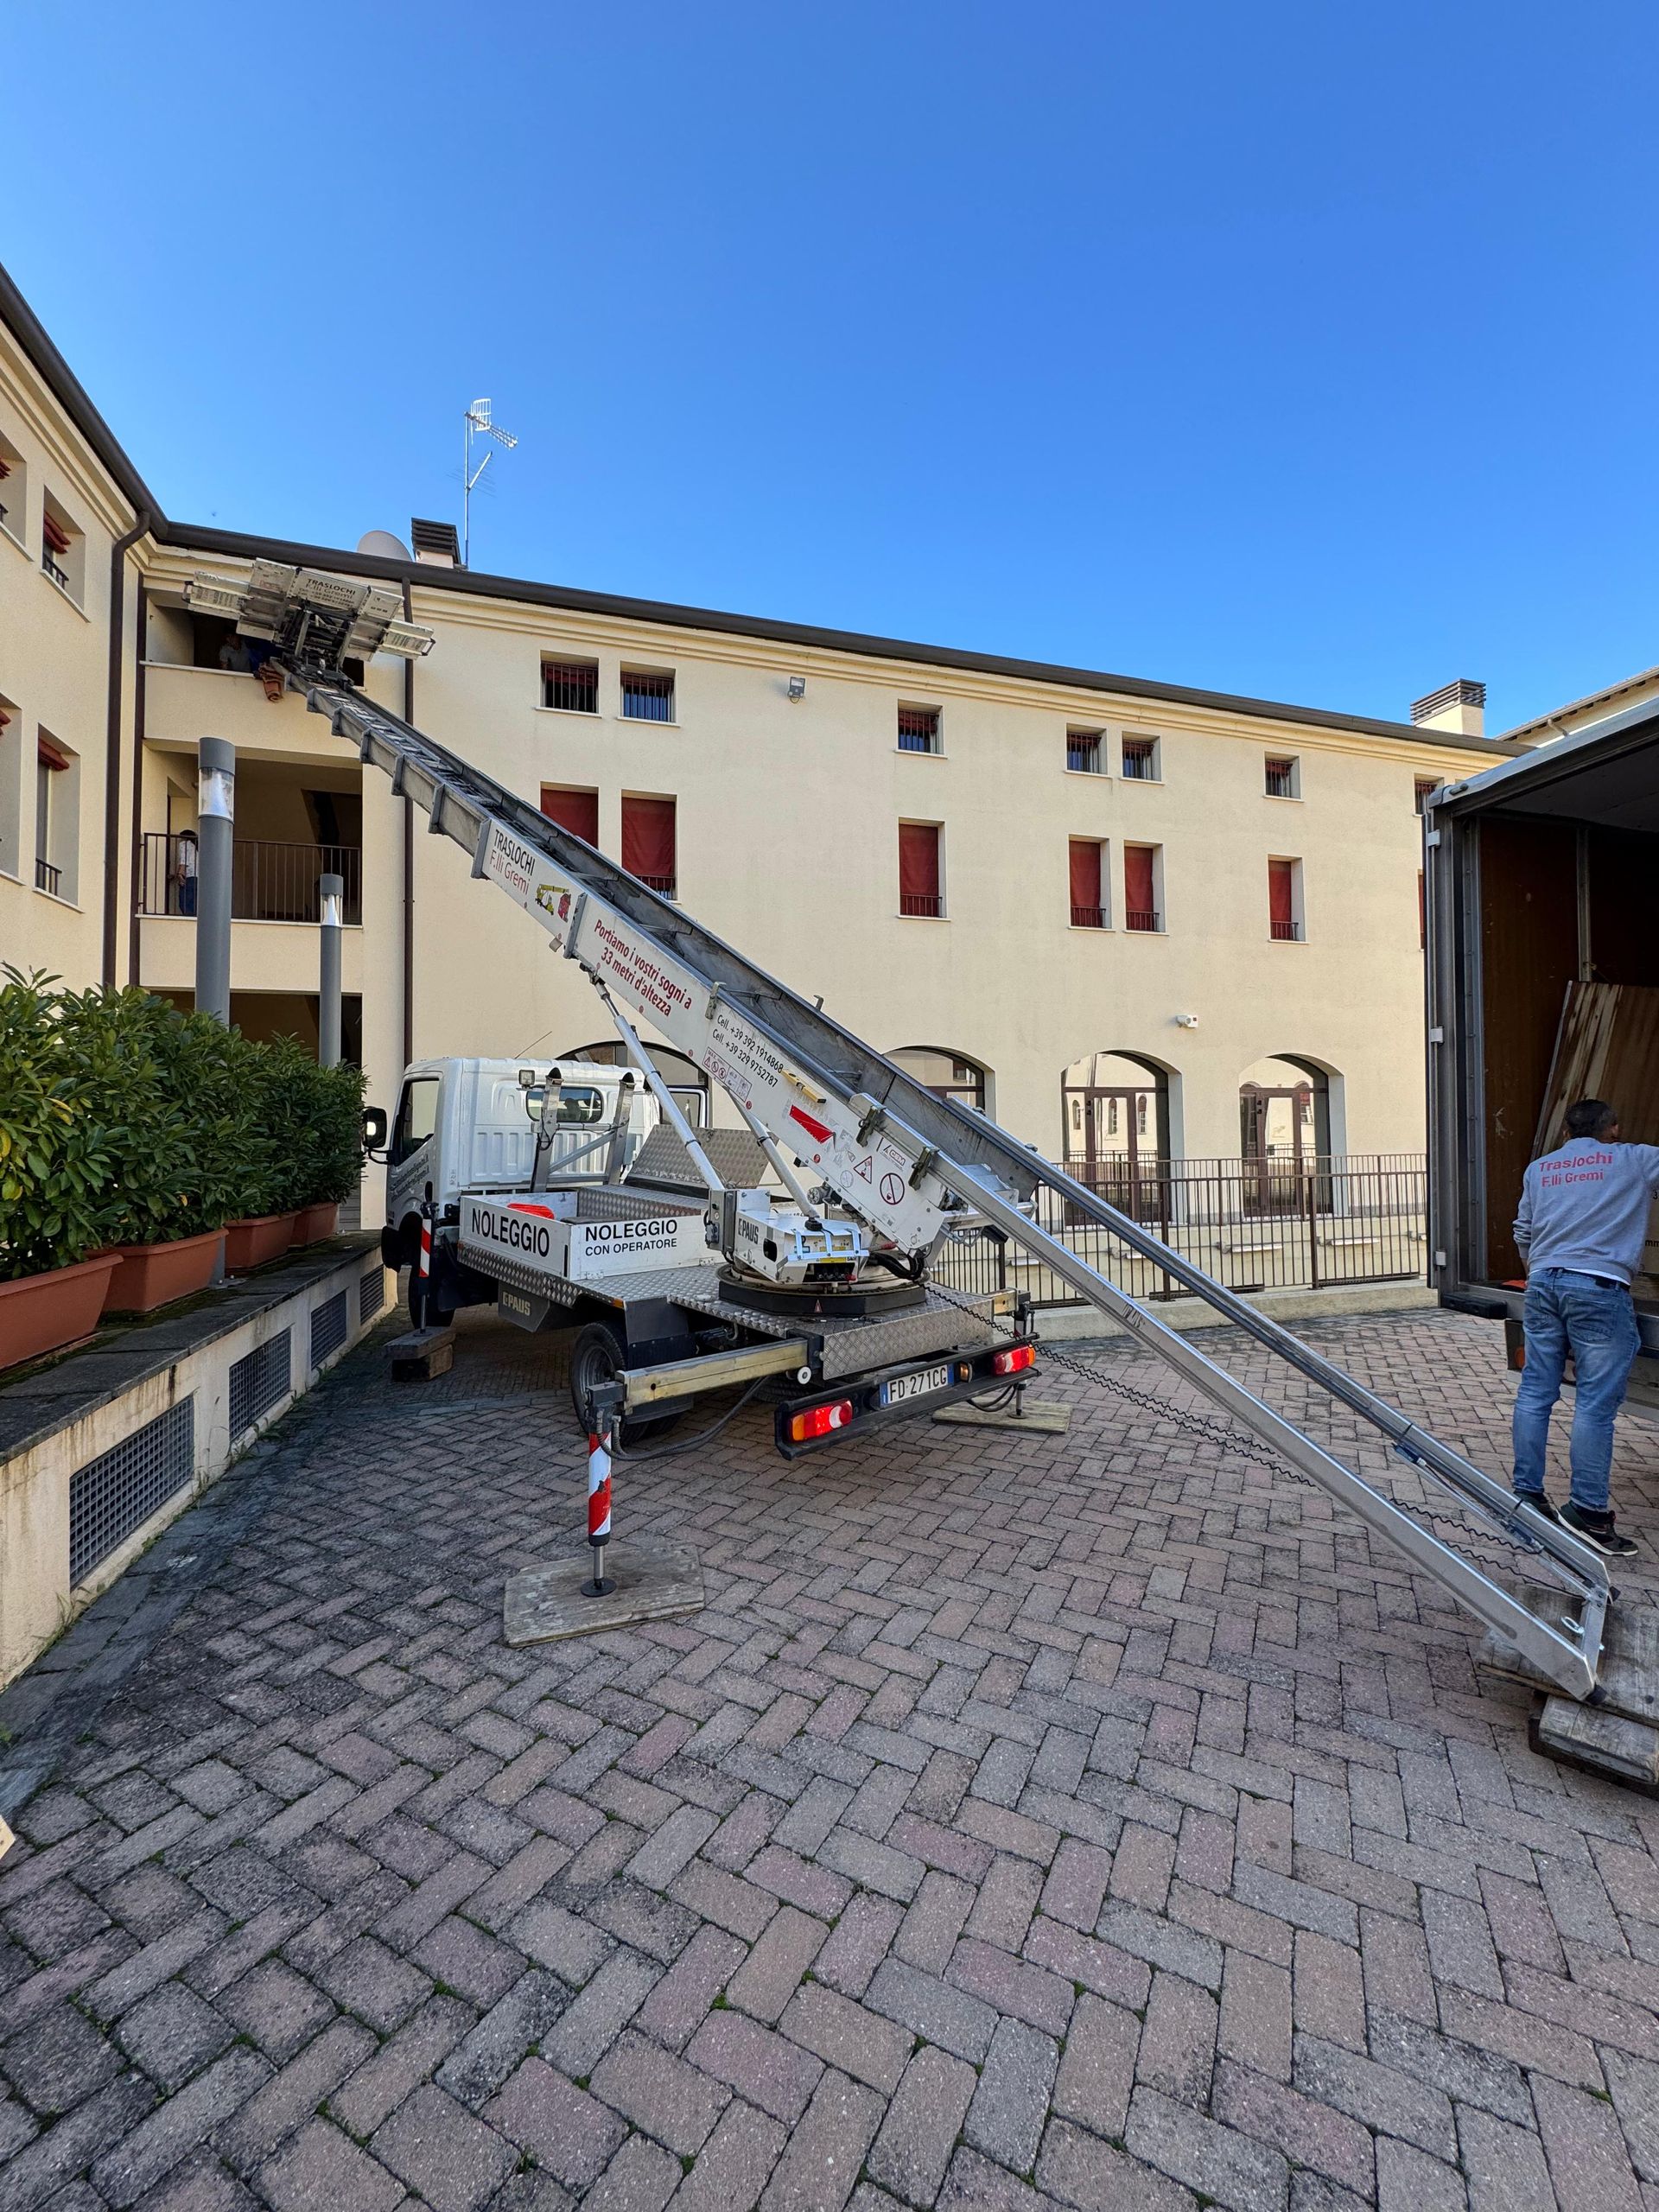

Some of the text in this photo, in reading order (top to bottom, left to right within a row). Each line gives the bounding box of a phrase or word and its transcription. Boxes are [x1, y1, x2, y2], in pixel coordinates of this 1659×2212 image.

[308, 579, 356, 595] TRASLOCHI
[490, 849, 531, 895] F.lli Gremi
[495, 829, 536, 876] TRASLOCHI
[594, 919, 692, 1010] Portiamo i vostri sogni a
[601, 946, 671, 1017] 33 metri d'altezza
[712, 1028, 725, 1046] Cell.
[725, 1041, 739, 1055] +39
[737, 1050, 751, 1065] 329
[750, 1059, 779, 1088] 9752787
[717, 1014, 784, 1074] Cell. +39 392 1914868
[1540, 1152, 1613, 1172] Traslochi
[1541, 1169, 1604, 1188] F.lli Gremi
[472, 1207, 550, 1257] NOLEGGIO
[585, 1219, 677, 1242] NOLEGGIO
[585, 1238, 677, 1256] CON OPERATORE
